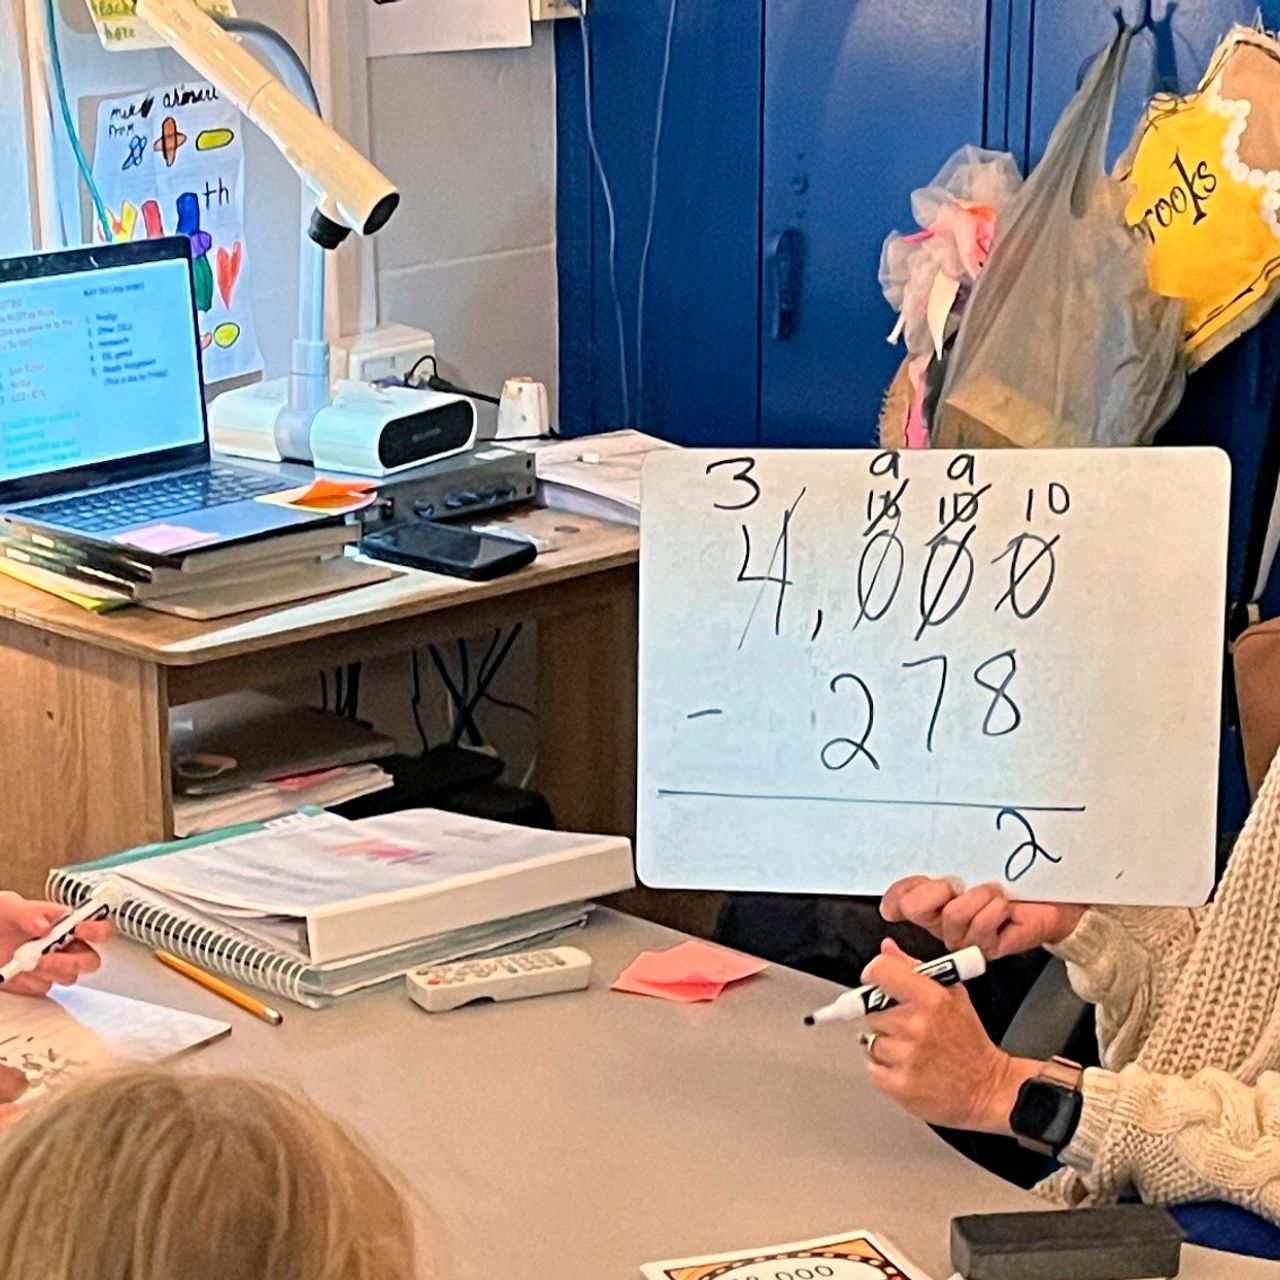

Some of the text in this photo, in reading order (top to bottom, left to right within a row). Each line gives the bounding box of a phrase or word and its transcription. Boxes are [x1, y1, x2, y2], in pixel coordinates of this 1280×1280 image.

[705, 456, 761, 511] 3
[1025, 482, 1071, 523] 10
[820, 648, 1021, 771] 278
[995, 807, 1063, 882] 2
